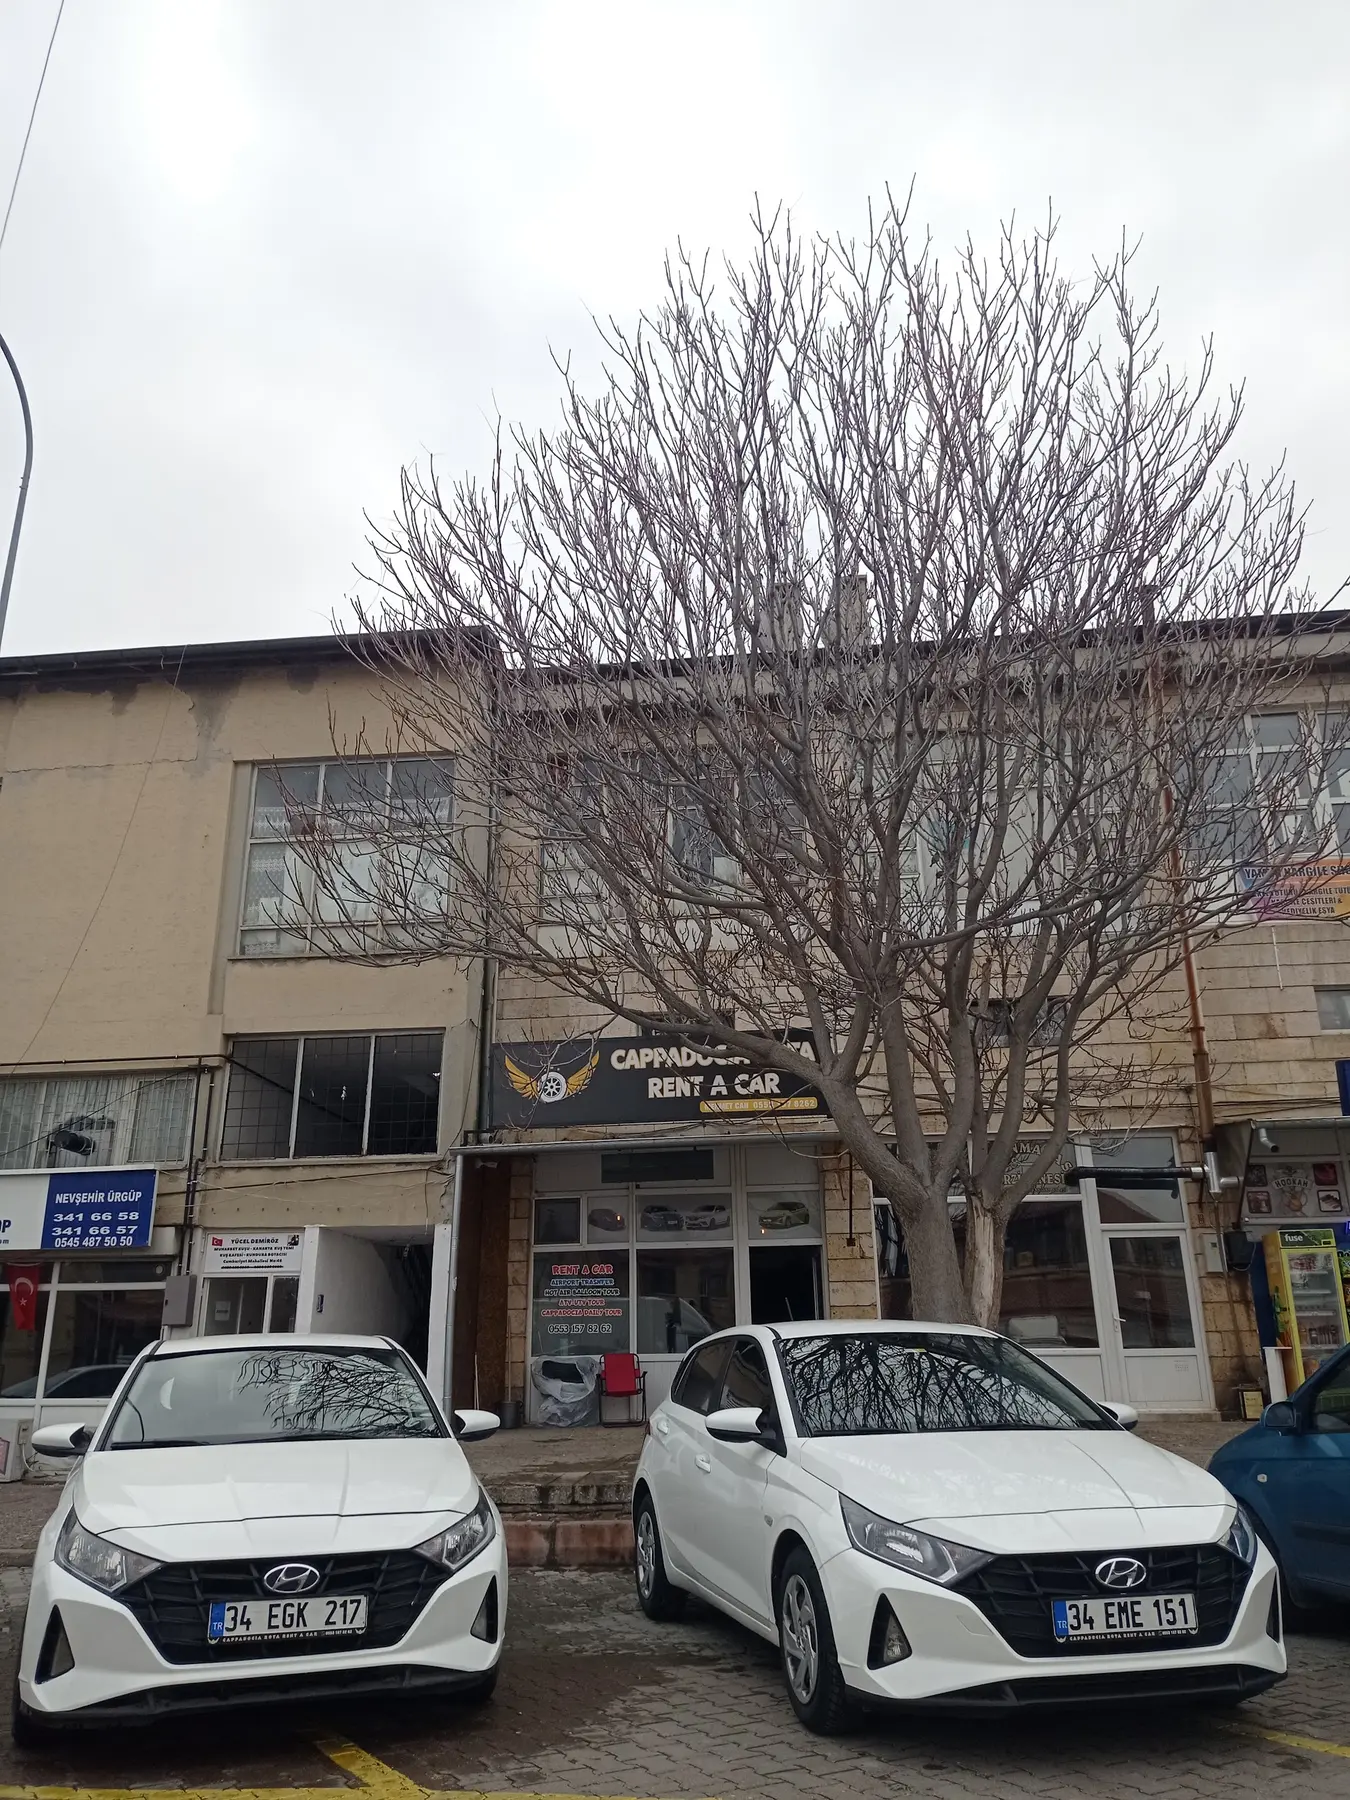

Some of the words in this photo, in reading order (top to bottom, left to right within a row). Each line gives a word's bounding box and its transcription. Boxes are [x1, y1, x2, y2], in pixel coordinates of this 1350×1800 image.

[648, 1075, 704, 1099] RENT
[710, 1074, 728, 1096] A
[734, 1072, 781, 1095] CAR
[1274, 1178, 1308, 1187] HOOKAH
[55, 1190, 105, 1206] NEVŞEHİR
[107, 1189, 142, 1202] ÜRGÜP
[53, 1213, 84, 1222] 341
[90, 1212, 112, 1221] 66
[118, 1211, 139, 1221] 58
[0, 1219, 11, 1233] P
[51, 1226, 82, 1236] 341
[88, 1226, 111, 1235] 66
[116, 1225, 138, 1234] 57
[54, 1237, 79, 1248] 0545
[82, 1236, 101, 1247] 487
[104, 1236, 117, 1247] 50
[119, 1235, 133, 1246] 50
[250, 1236, 279, 1244] DEMİRÖZ
[1284, 1233, 1303, 1242] fuse
[552, 1265, 580, 1275] RENT
[581, 1265, 590, 1275] A
[591, 1264, 614, 1274] CAR
[572, 1288, 602, 1296] BALLOON
[602, 1288, 620, 1296] TOUR
[588, 1298, 605, 1306] TOUR
[604, 1308, 622, 1316] TOUR
[548, 1324, 569, 1334] 0553
[571, 1323, 585, 1334] 157
[587, 1324, 599, 1333] 82
[600, 1323, 612, 1333] 62
[212, 1621, 223, 1631] TR
[224, 1605, 252, 1632] 34
[267, 1602, 309, 1630] EGK
[324, 1599, 362, 1626] 217
[1057, 1620, 1067, 1629] TR
[1068, 1603, 1094, 1631] 34
[1104, 1601, 1144, 1630] EME
[1153, 1598, 1188, 1626] 151
